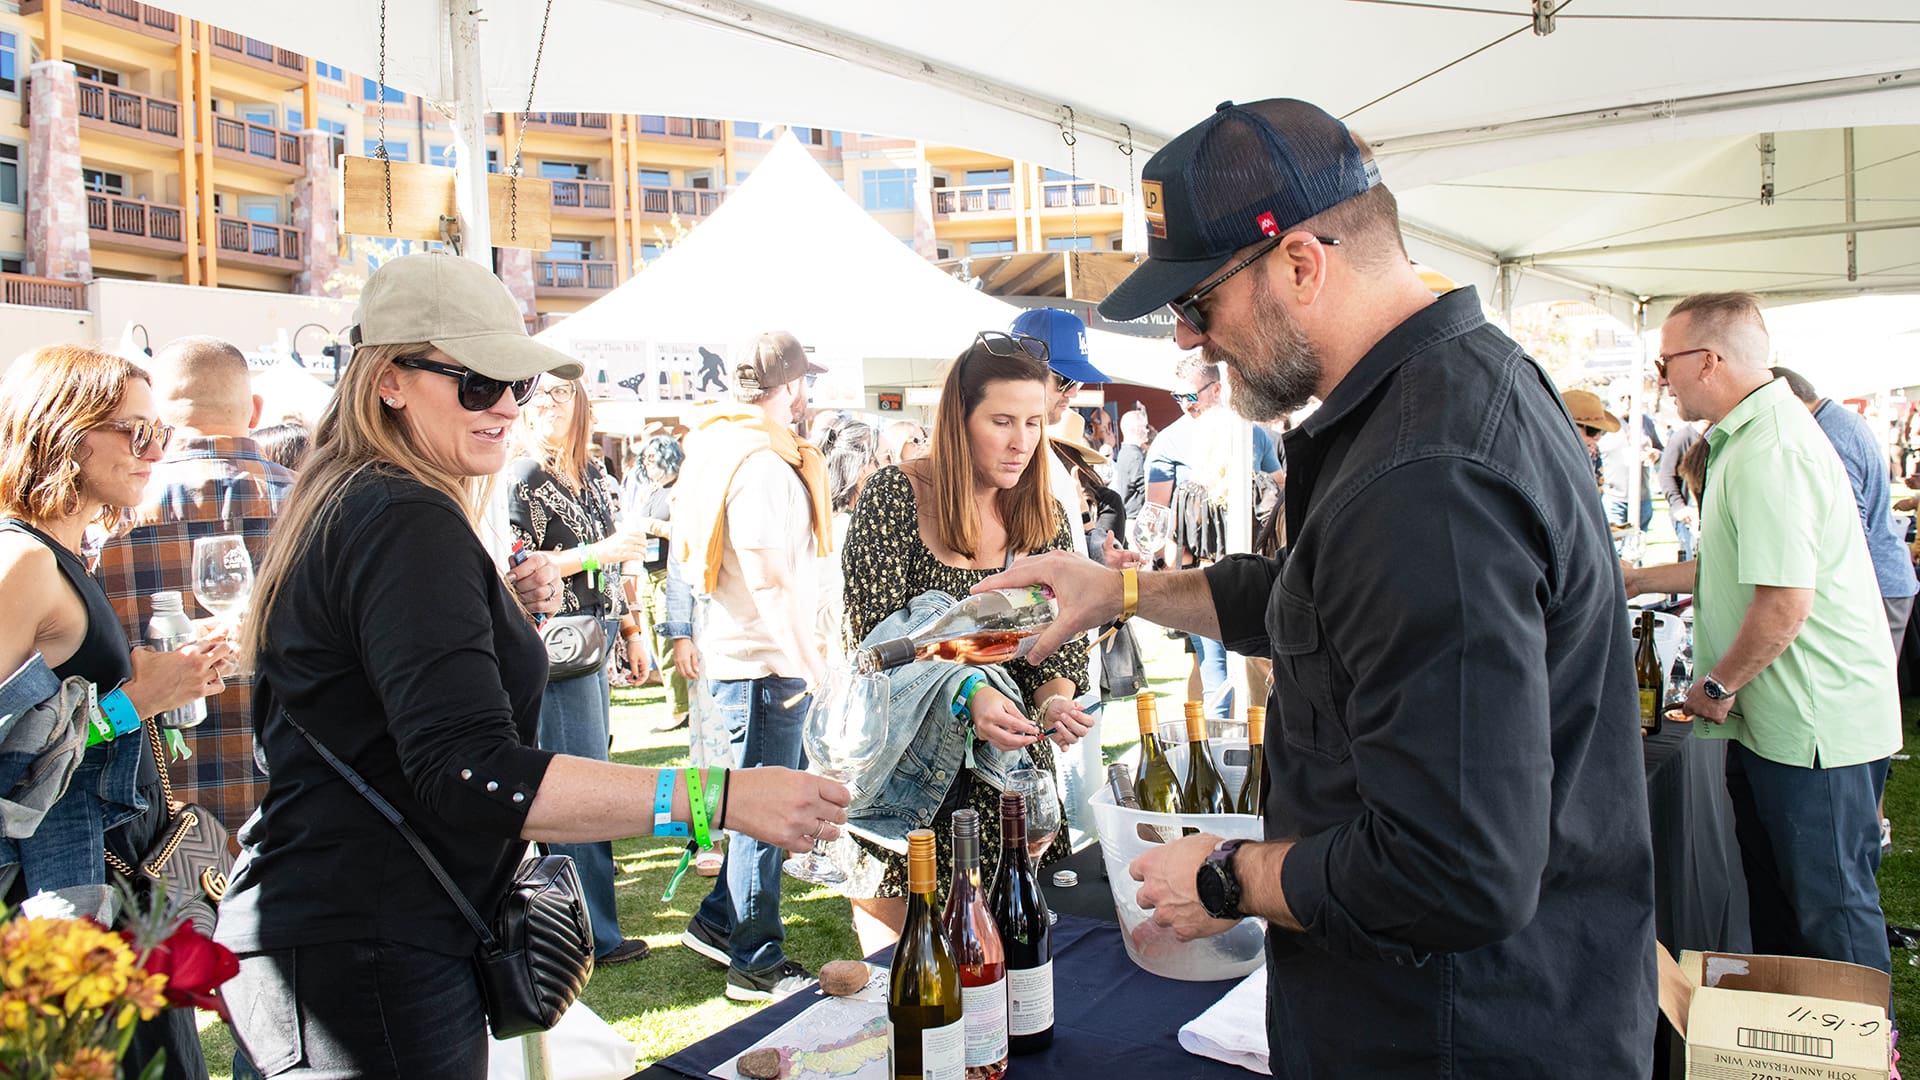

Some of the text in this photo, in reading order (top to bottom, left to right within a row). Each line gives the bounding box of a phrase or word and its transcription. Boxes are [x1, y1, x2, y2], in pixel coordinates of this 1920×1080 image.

[1150, 314, 1177, 325] VILLA
[1713, 1053, 1743, 1067] WINE
[1746, 1058, 1823, 1078] ANNIVERSARY
